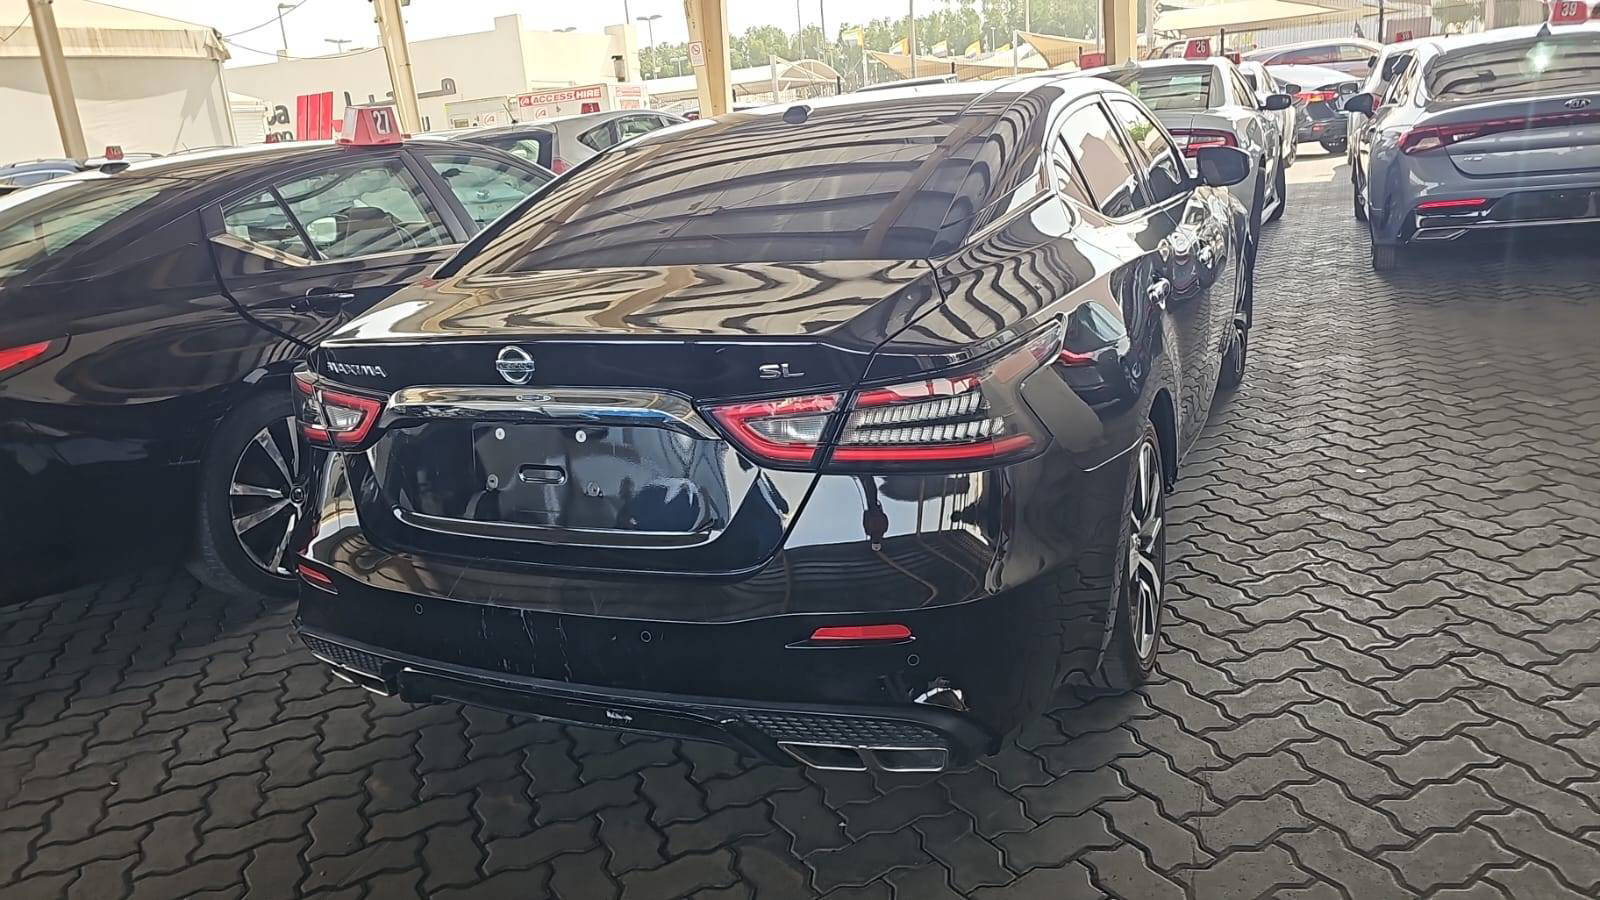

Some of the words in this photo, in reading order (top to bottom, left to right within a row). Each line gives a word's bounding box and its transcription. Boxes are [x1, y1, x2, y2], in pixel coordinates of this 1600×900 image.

[1196, 40, 1206, 53] 26
[533, 93, 573, 104] ACCESS
[575, 88, 601, 99] HIRE
[373, 110, 391, 134] 27
[327, 361, 386, 378] MAXIMA
[759, 363, 805, 378] SL
